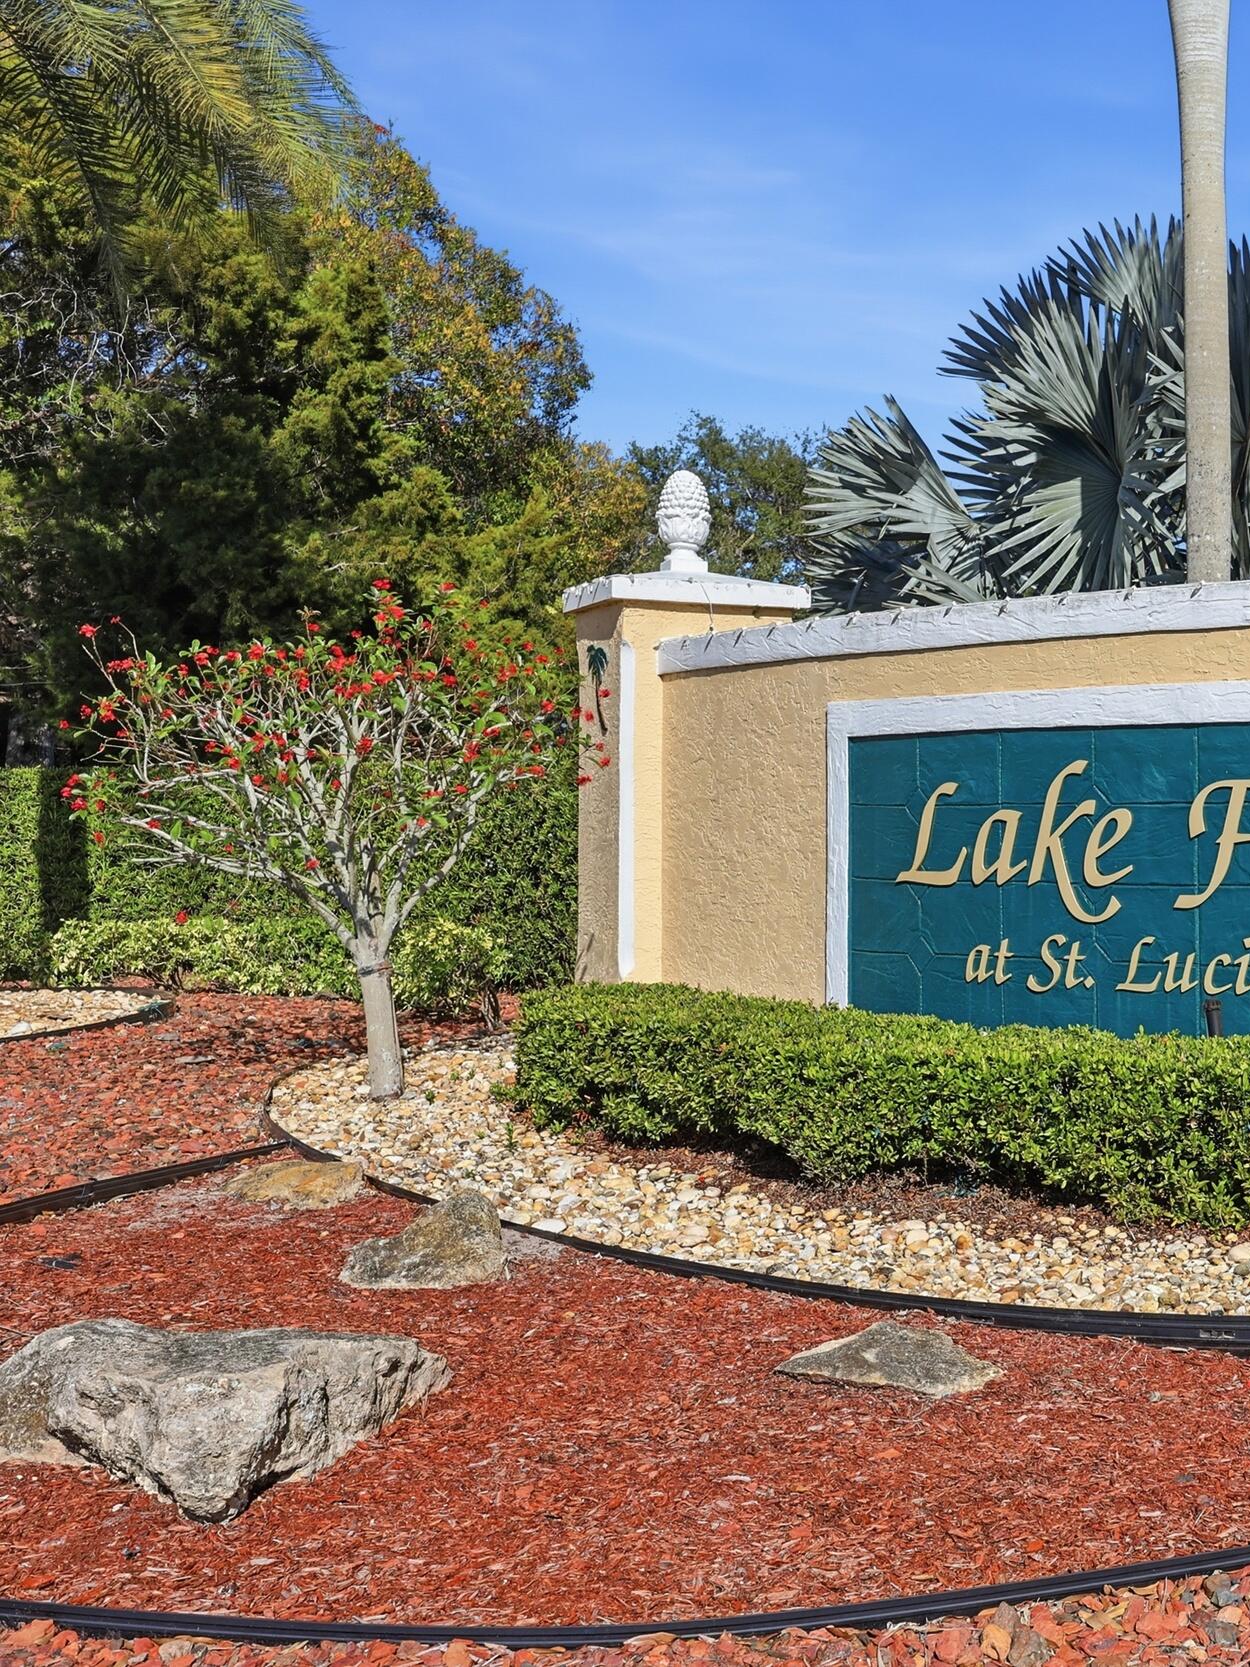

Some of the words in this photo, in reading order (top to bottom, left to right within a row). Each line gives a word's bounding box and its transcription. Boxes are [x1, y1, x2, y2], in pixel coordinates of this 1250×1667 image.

[896, 759, 1133, 923] Lake
[965, 938, 1014, 985] at
[1027, 934, 1094, 993] St.
